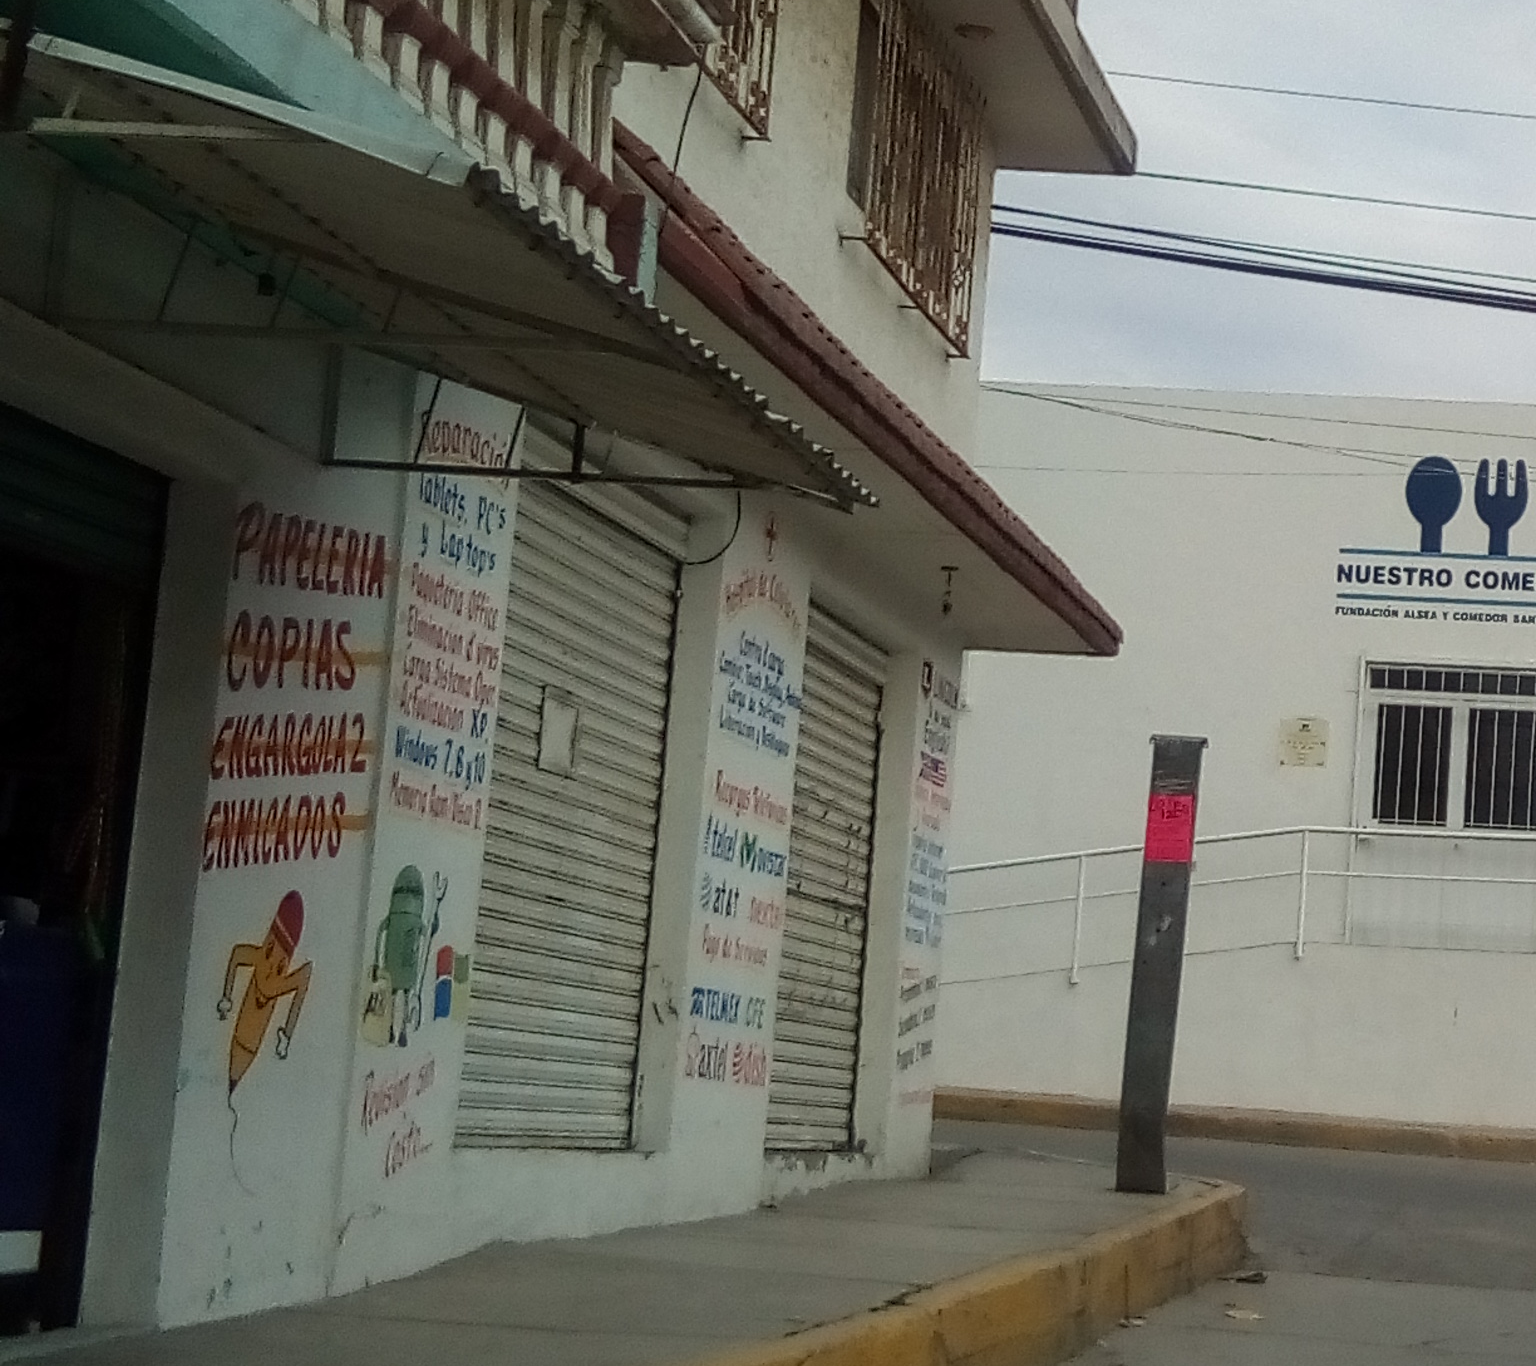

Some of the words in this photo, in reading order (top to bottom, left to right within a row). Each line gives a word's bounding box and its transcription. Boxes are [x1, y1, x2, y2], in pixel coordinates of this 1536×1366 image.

[232, 501, 385, 599] PAPELERIA
[1336, 563, 1453, 588] NUESTRO
[226, 609, 356, 692] COPIAS
[1335, 605, 1399, 618] FUNDACIÓN
[1443, 611, 1449, 620] Y
[1453, 611, 1508, 623] COMEDOR
[203, 792, 346, 872] ENMICADOS
